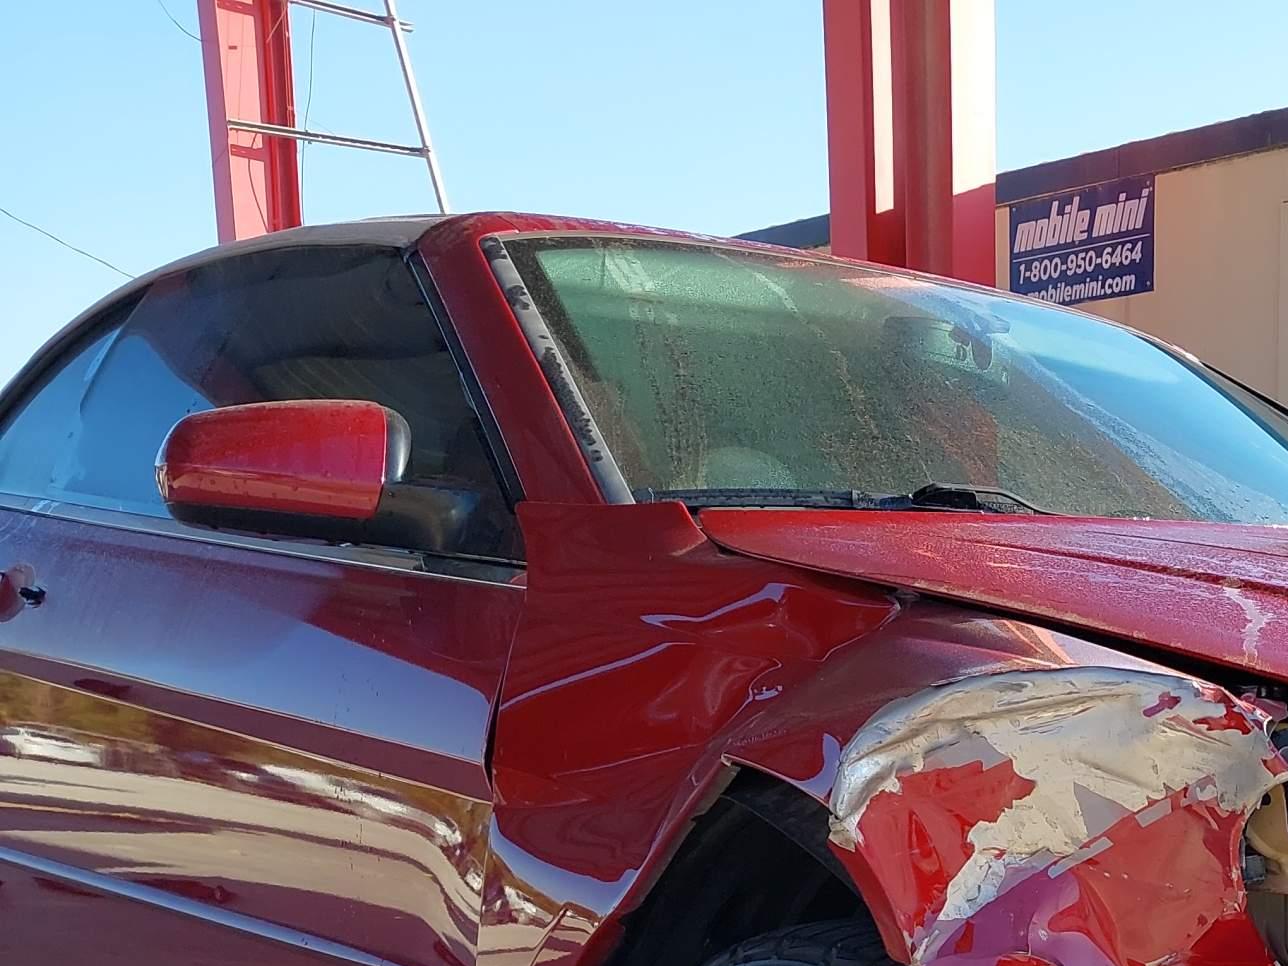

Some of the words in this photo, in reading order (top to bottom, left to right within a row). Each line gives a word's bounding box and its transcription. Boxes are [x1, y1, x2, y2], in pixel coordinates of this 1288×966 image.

[1013, 196, 1090, 253] mobile
[1092, 188, 1149, 237] mini
[1019, 241, 1143, 284] 1-800-950-6464
